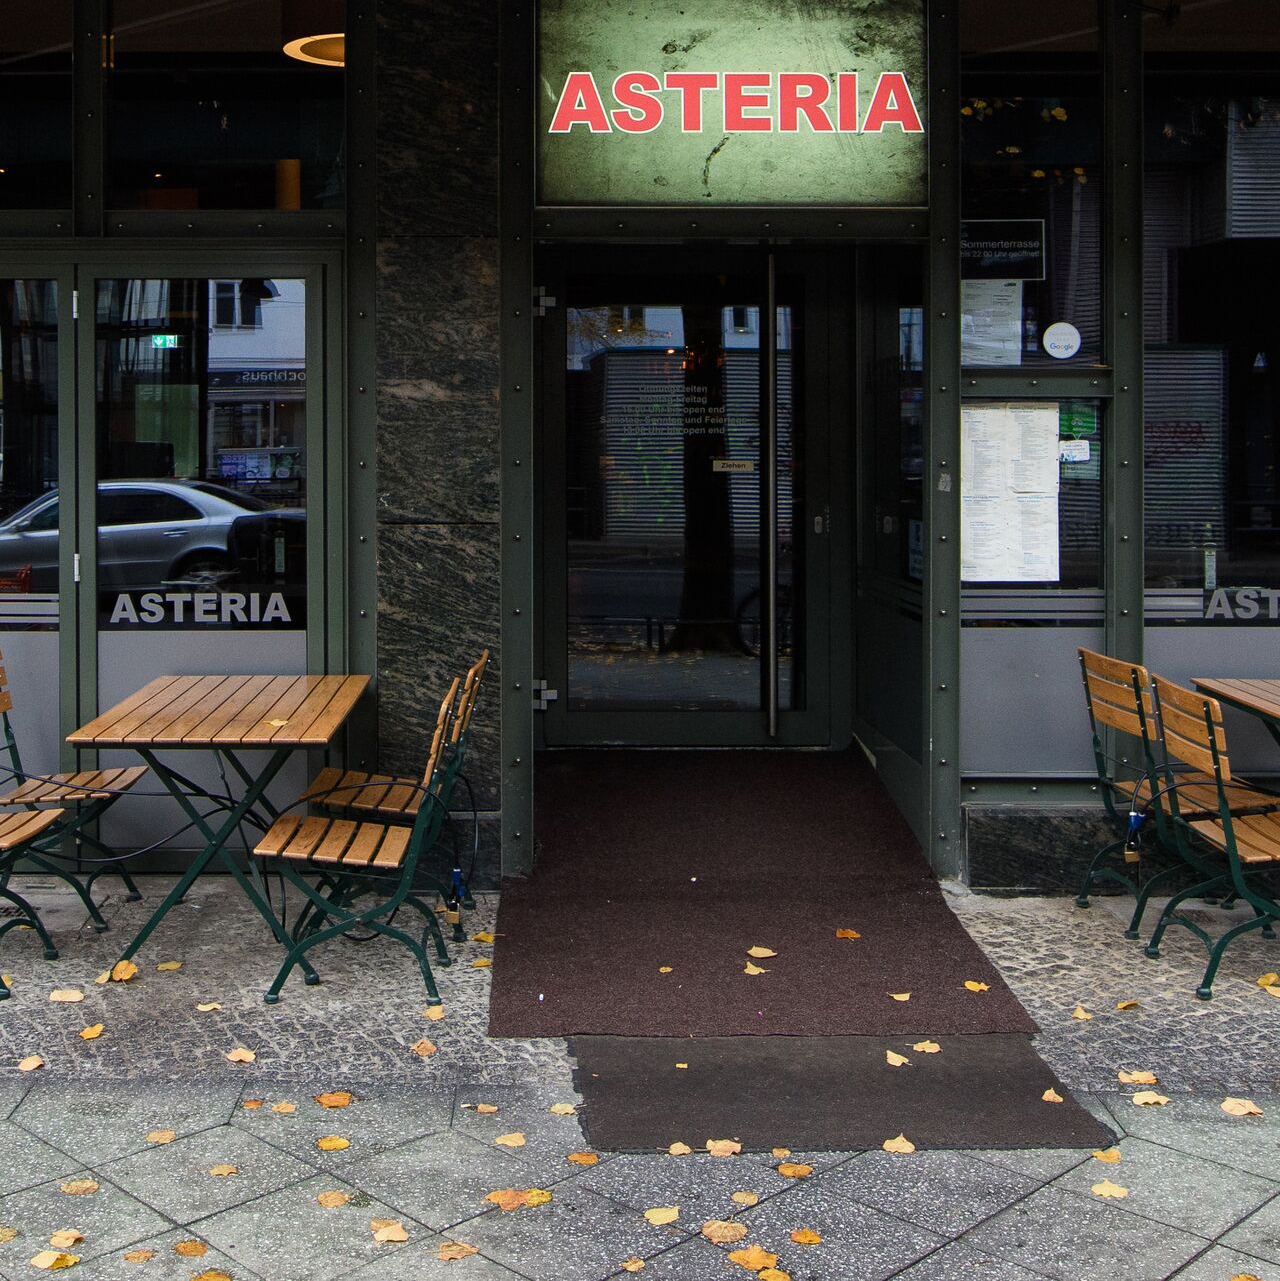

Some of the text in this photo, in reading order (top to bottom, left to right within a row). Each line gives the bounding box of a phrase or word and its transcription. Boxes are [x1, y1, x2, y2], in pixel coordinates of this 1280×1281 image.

[548, 71, 925, 134] ASTERIA
[960, 240, 1040, 249] Sommerterrasse
[1050, 342, 1073, 351] Google
[683, 407, 706, 415] open
[685, 416, 702, 424] und
[683, 428, 706, 436] open
[110, 592, 291, 623] ASTERIA
